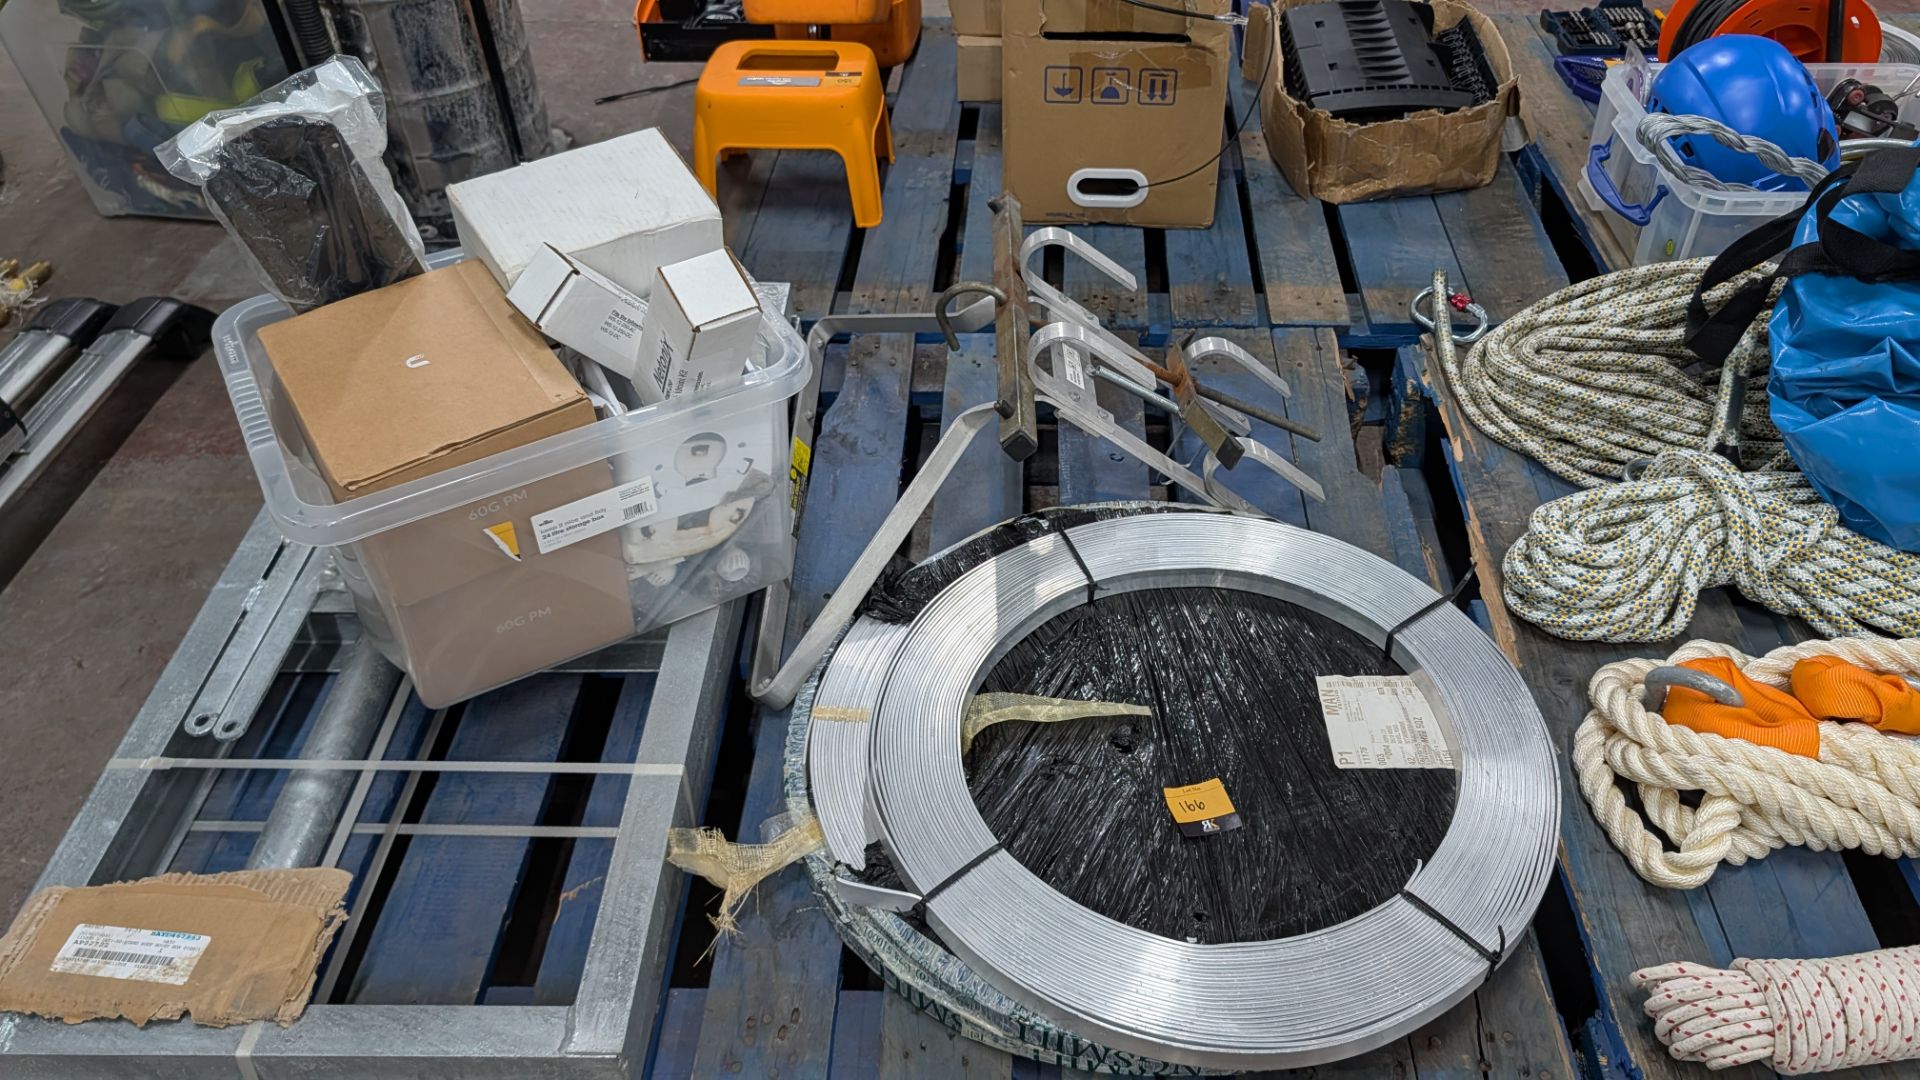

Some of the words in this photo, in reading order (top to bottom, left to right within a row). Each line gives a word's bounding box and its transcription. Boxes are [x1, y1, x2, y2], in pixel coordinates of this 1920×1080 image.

[469, 501, 501, 521] 60G
[503, 489, 528, 507] PM
[565, 519, 591, 532] storage
[528, 605, 552, 623] PM
[1321, 689, 1340, 716] MAN
[1338, 751, 1355, 765] P1
[1178, 799, 1206, 814] 166
